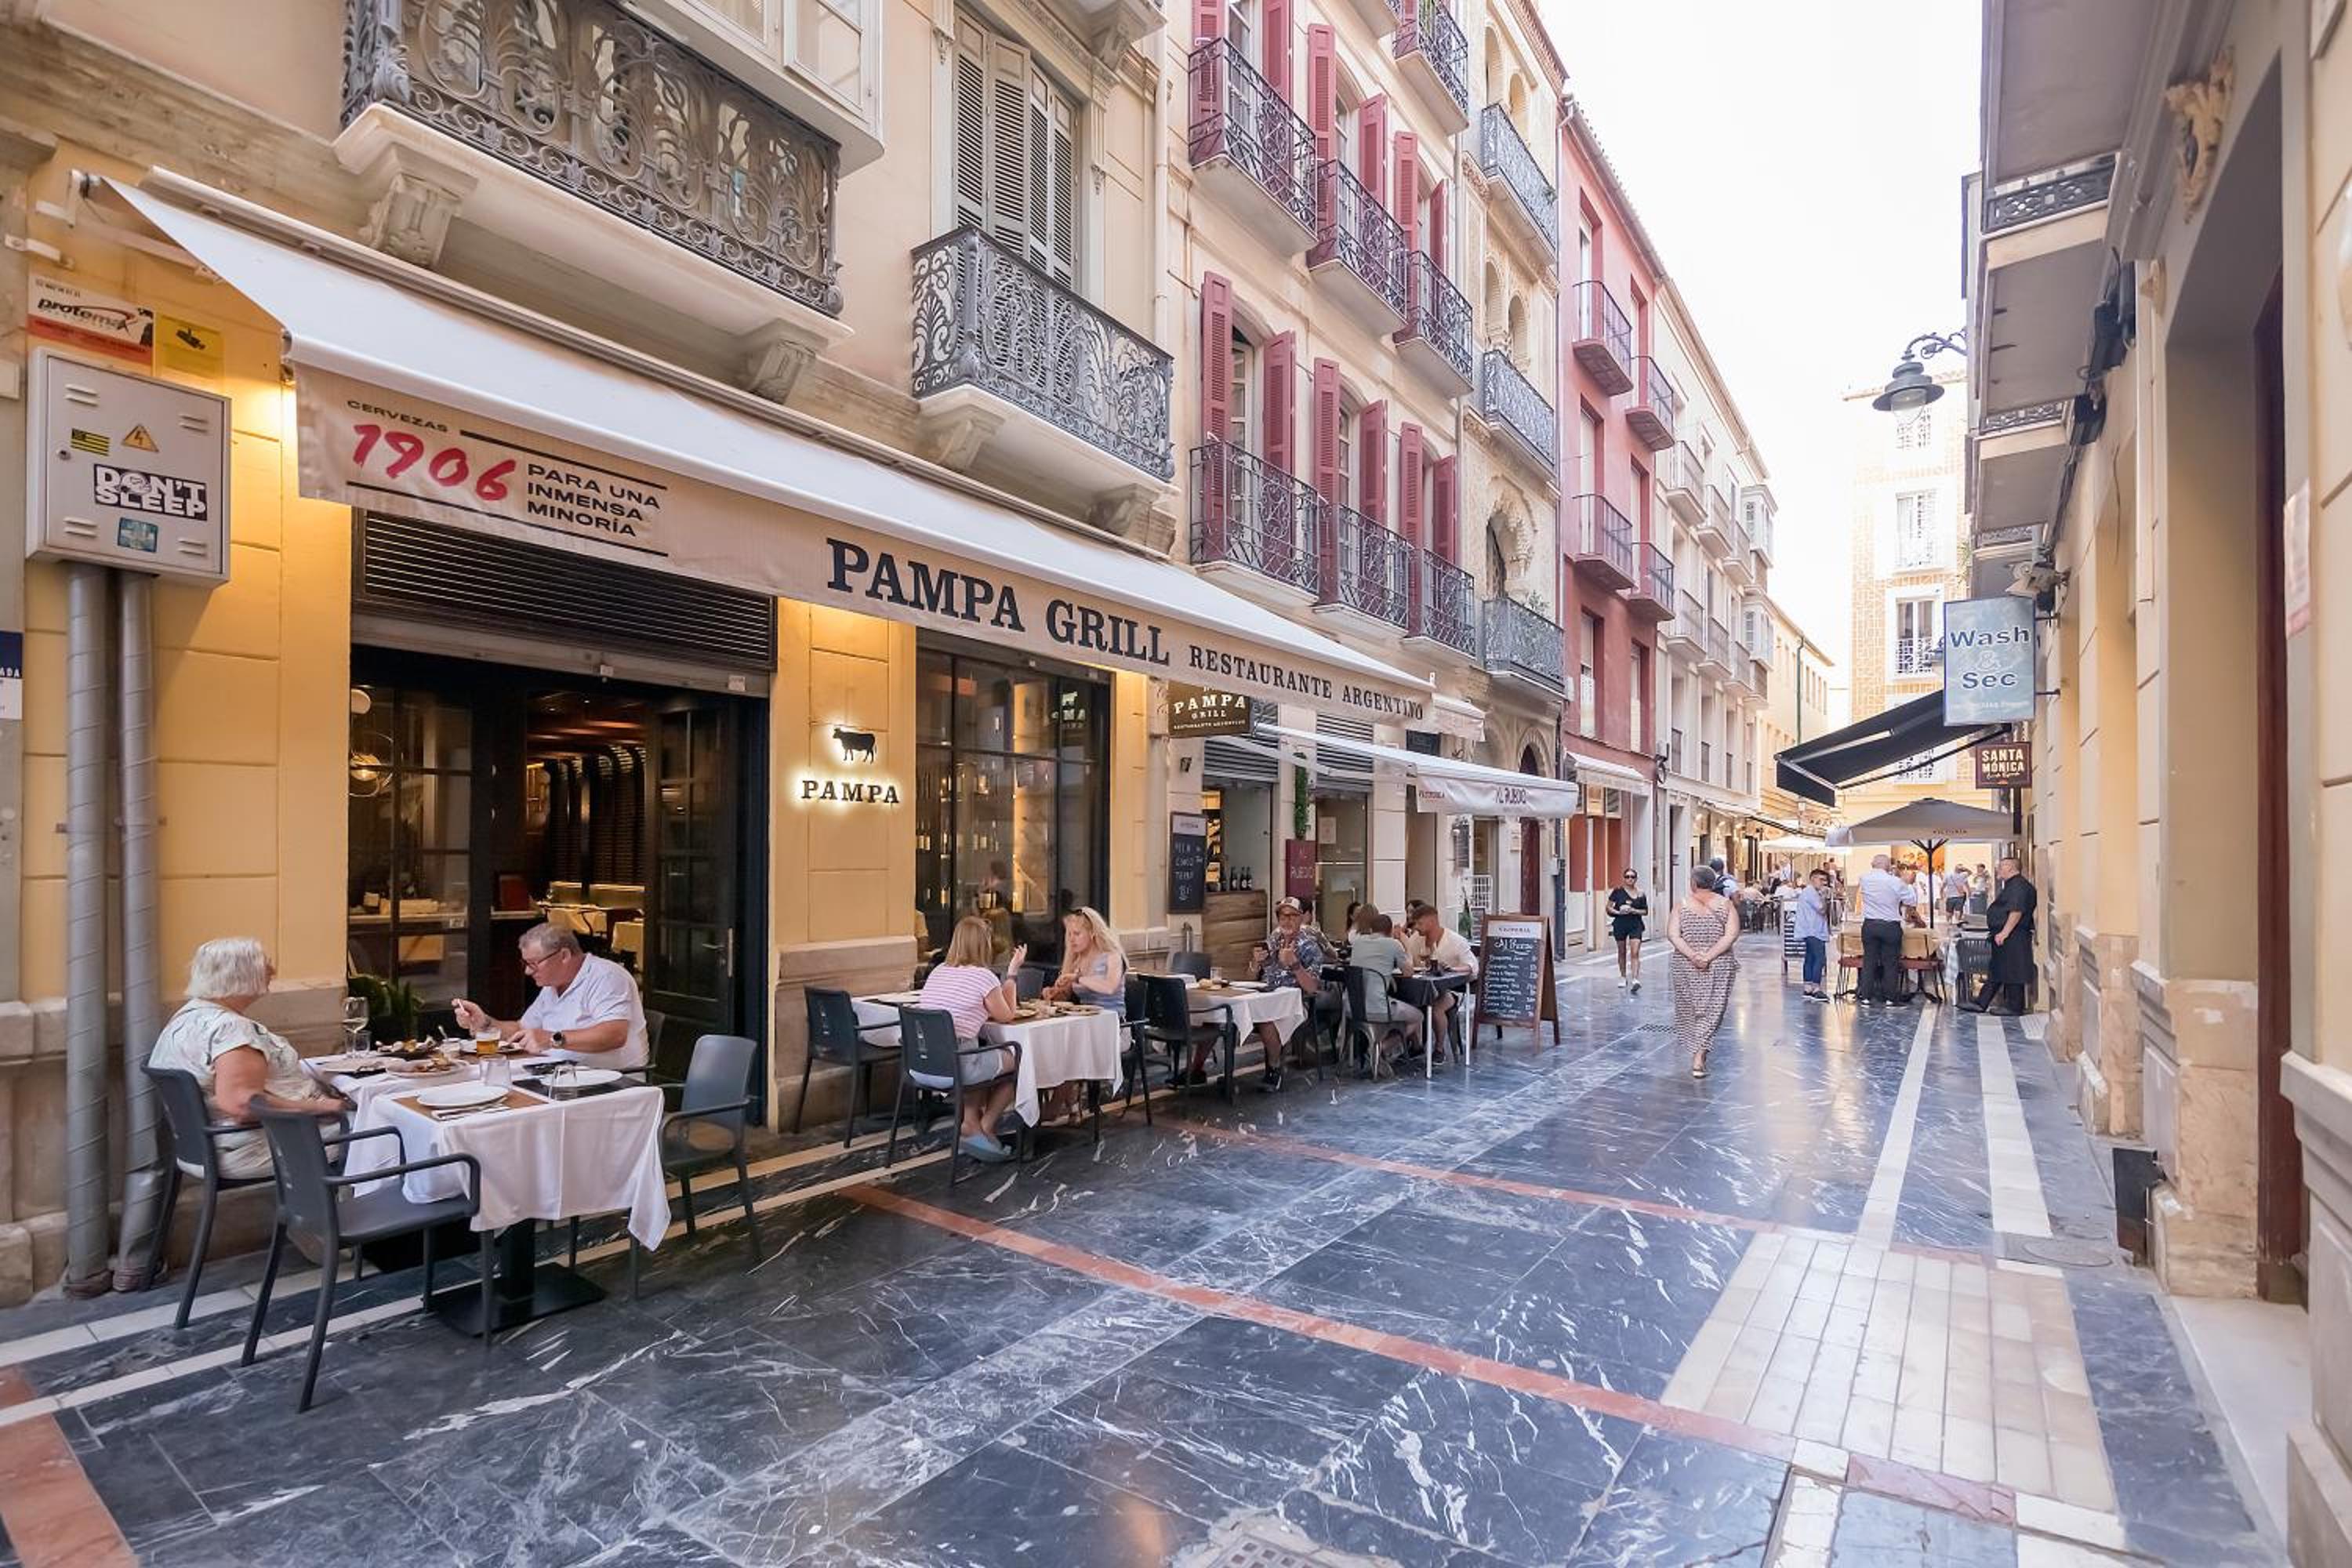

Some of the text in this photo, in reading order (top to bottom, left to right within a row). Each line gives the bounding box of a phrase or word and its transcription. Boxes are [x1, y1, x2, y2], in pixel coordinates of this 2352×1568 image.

[347, 400, 448, 433] CERVEZAS
[353, 424, 517, 501] 1906
[528, 463, 660, 510] PARA UNA
[96, 485, 206, 517] SLEEP
[528, 482, 644, 521] INMENSA
[528, 501, 637, 537] MINORÍA
[826, 537, 1424, 720] PAMPA GRILL RESTAURANTE ARGENTINO
[1950, 626, 2030, 648] Wash
[1976, 650, 2002, 672] &
[1962, 672, 2016, 689] Sec
[1174, 694, 1246, 714] PAMPA
[1191, 710, 1227, 720] GRILL
[1982, 749, 2024, 762] SANTA
[1982, 760, 2025, 773] MÓNICA
[801, 780, 900, 804] PAMPA
